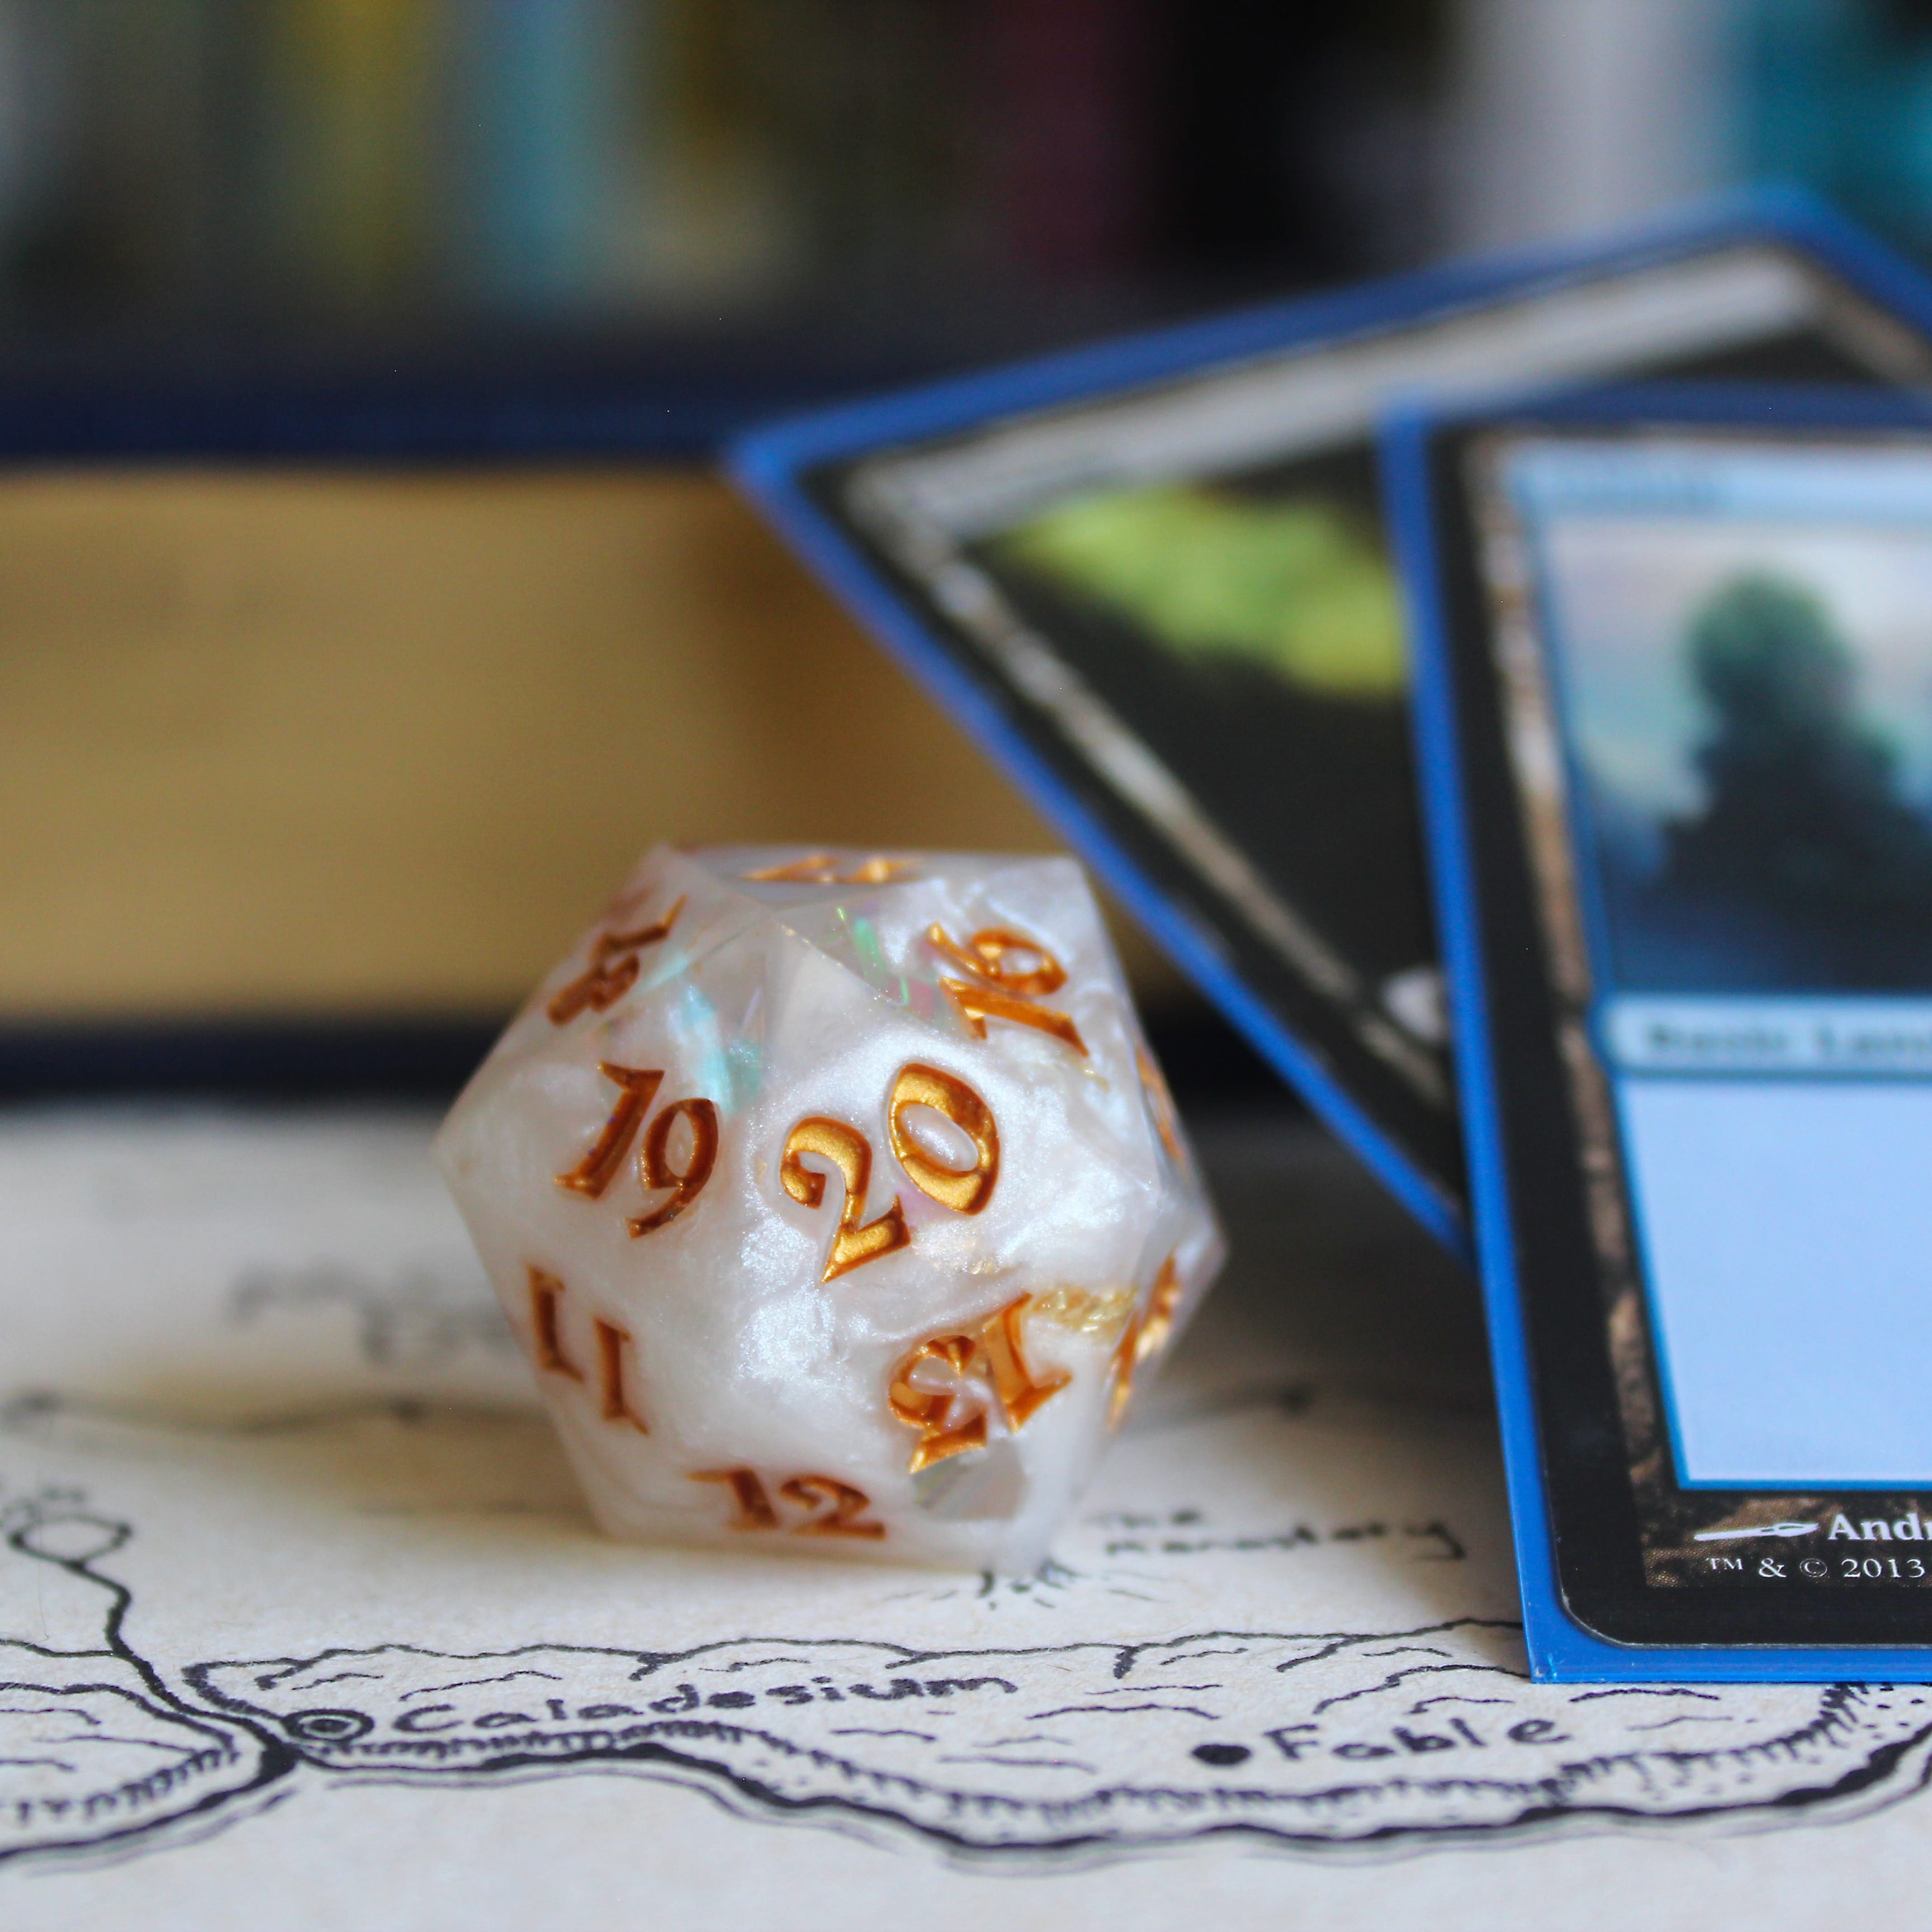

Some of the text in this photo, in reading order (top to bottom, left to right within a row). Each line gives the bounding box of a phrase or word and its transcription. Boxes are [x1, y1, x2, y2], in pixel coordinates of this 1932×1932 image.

[554, 1061, 719, 1239] 19
[780, 1063, 1000, 1284] 20
[525, 1262, 650, 1436] 11
[685, 1466, 886, 1541] 12
[1758, 1557, 1787, 1578] &
[1841, 1557, 1926, 1578] 2013
[391, 1677, 1017, 1732] Caladesium
[1263, 1718, 1571, 1760] Fable
